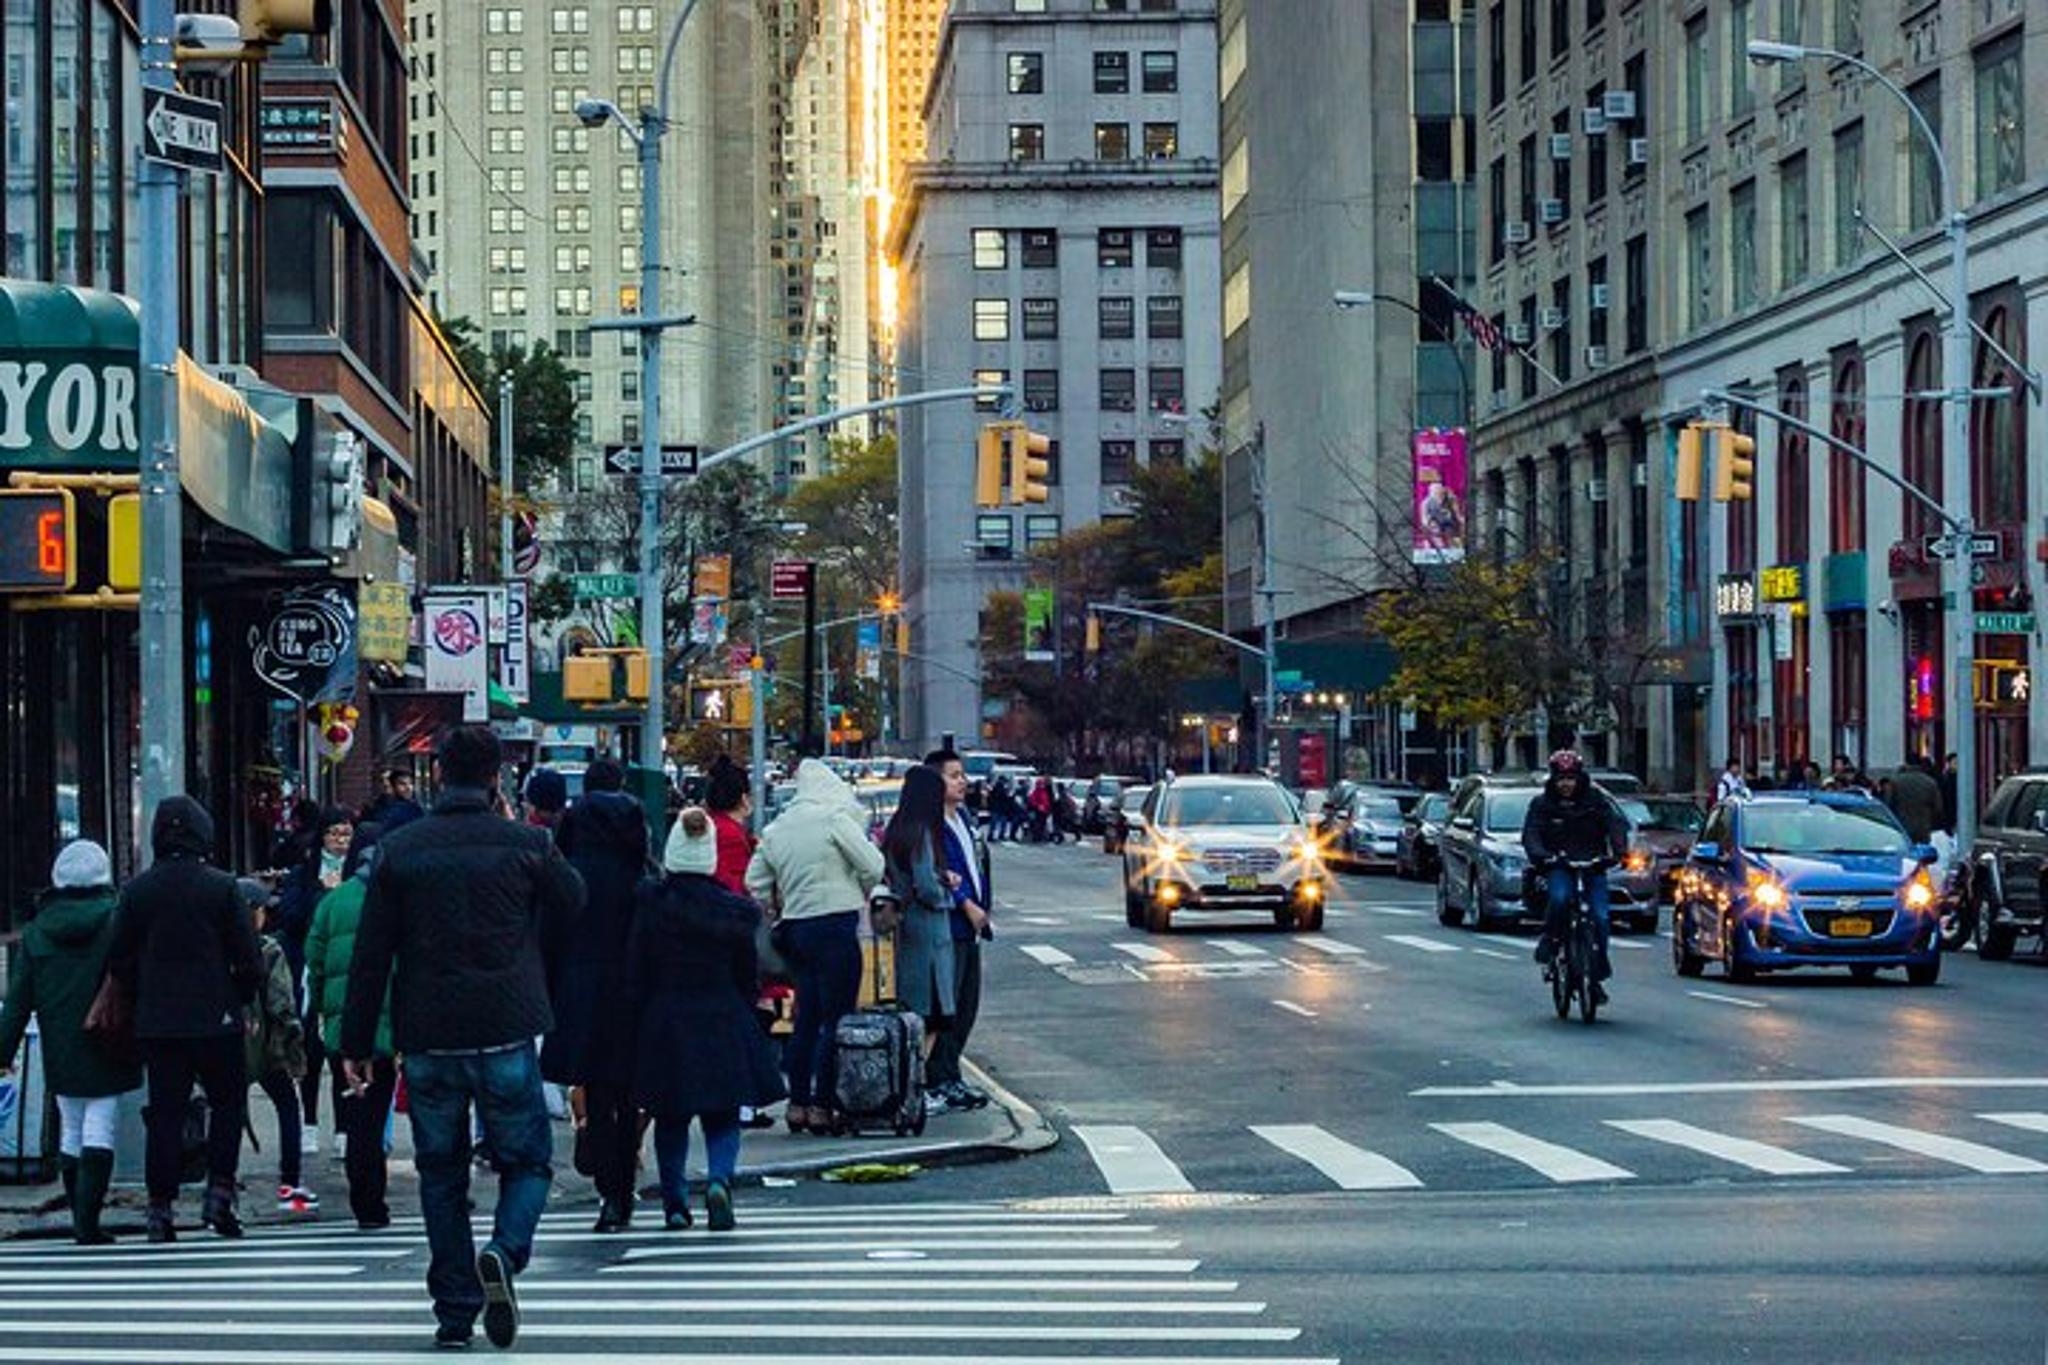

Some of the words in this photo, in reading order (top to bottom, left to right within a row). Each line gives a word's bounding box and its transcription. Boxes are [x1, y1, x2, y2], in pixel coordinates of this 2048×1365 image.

[155, 111, 177, 142] ONE
[186, 121, 214, 149] WAY
[38, 511, 65, 573] 6
[577, 577, 624, 593] WALKER
[279, 619, 317, 631] KUNG
[1978, 616, 2020, 629] WALKER
[279, 631, 297, 642] FU
[503, 600, 525, 686] DELI
[279, 643, 302, 655] TEA
